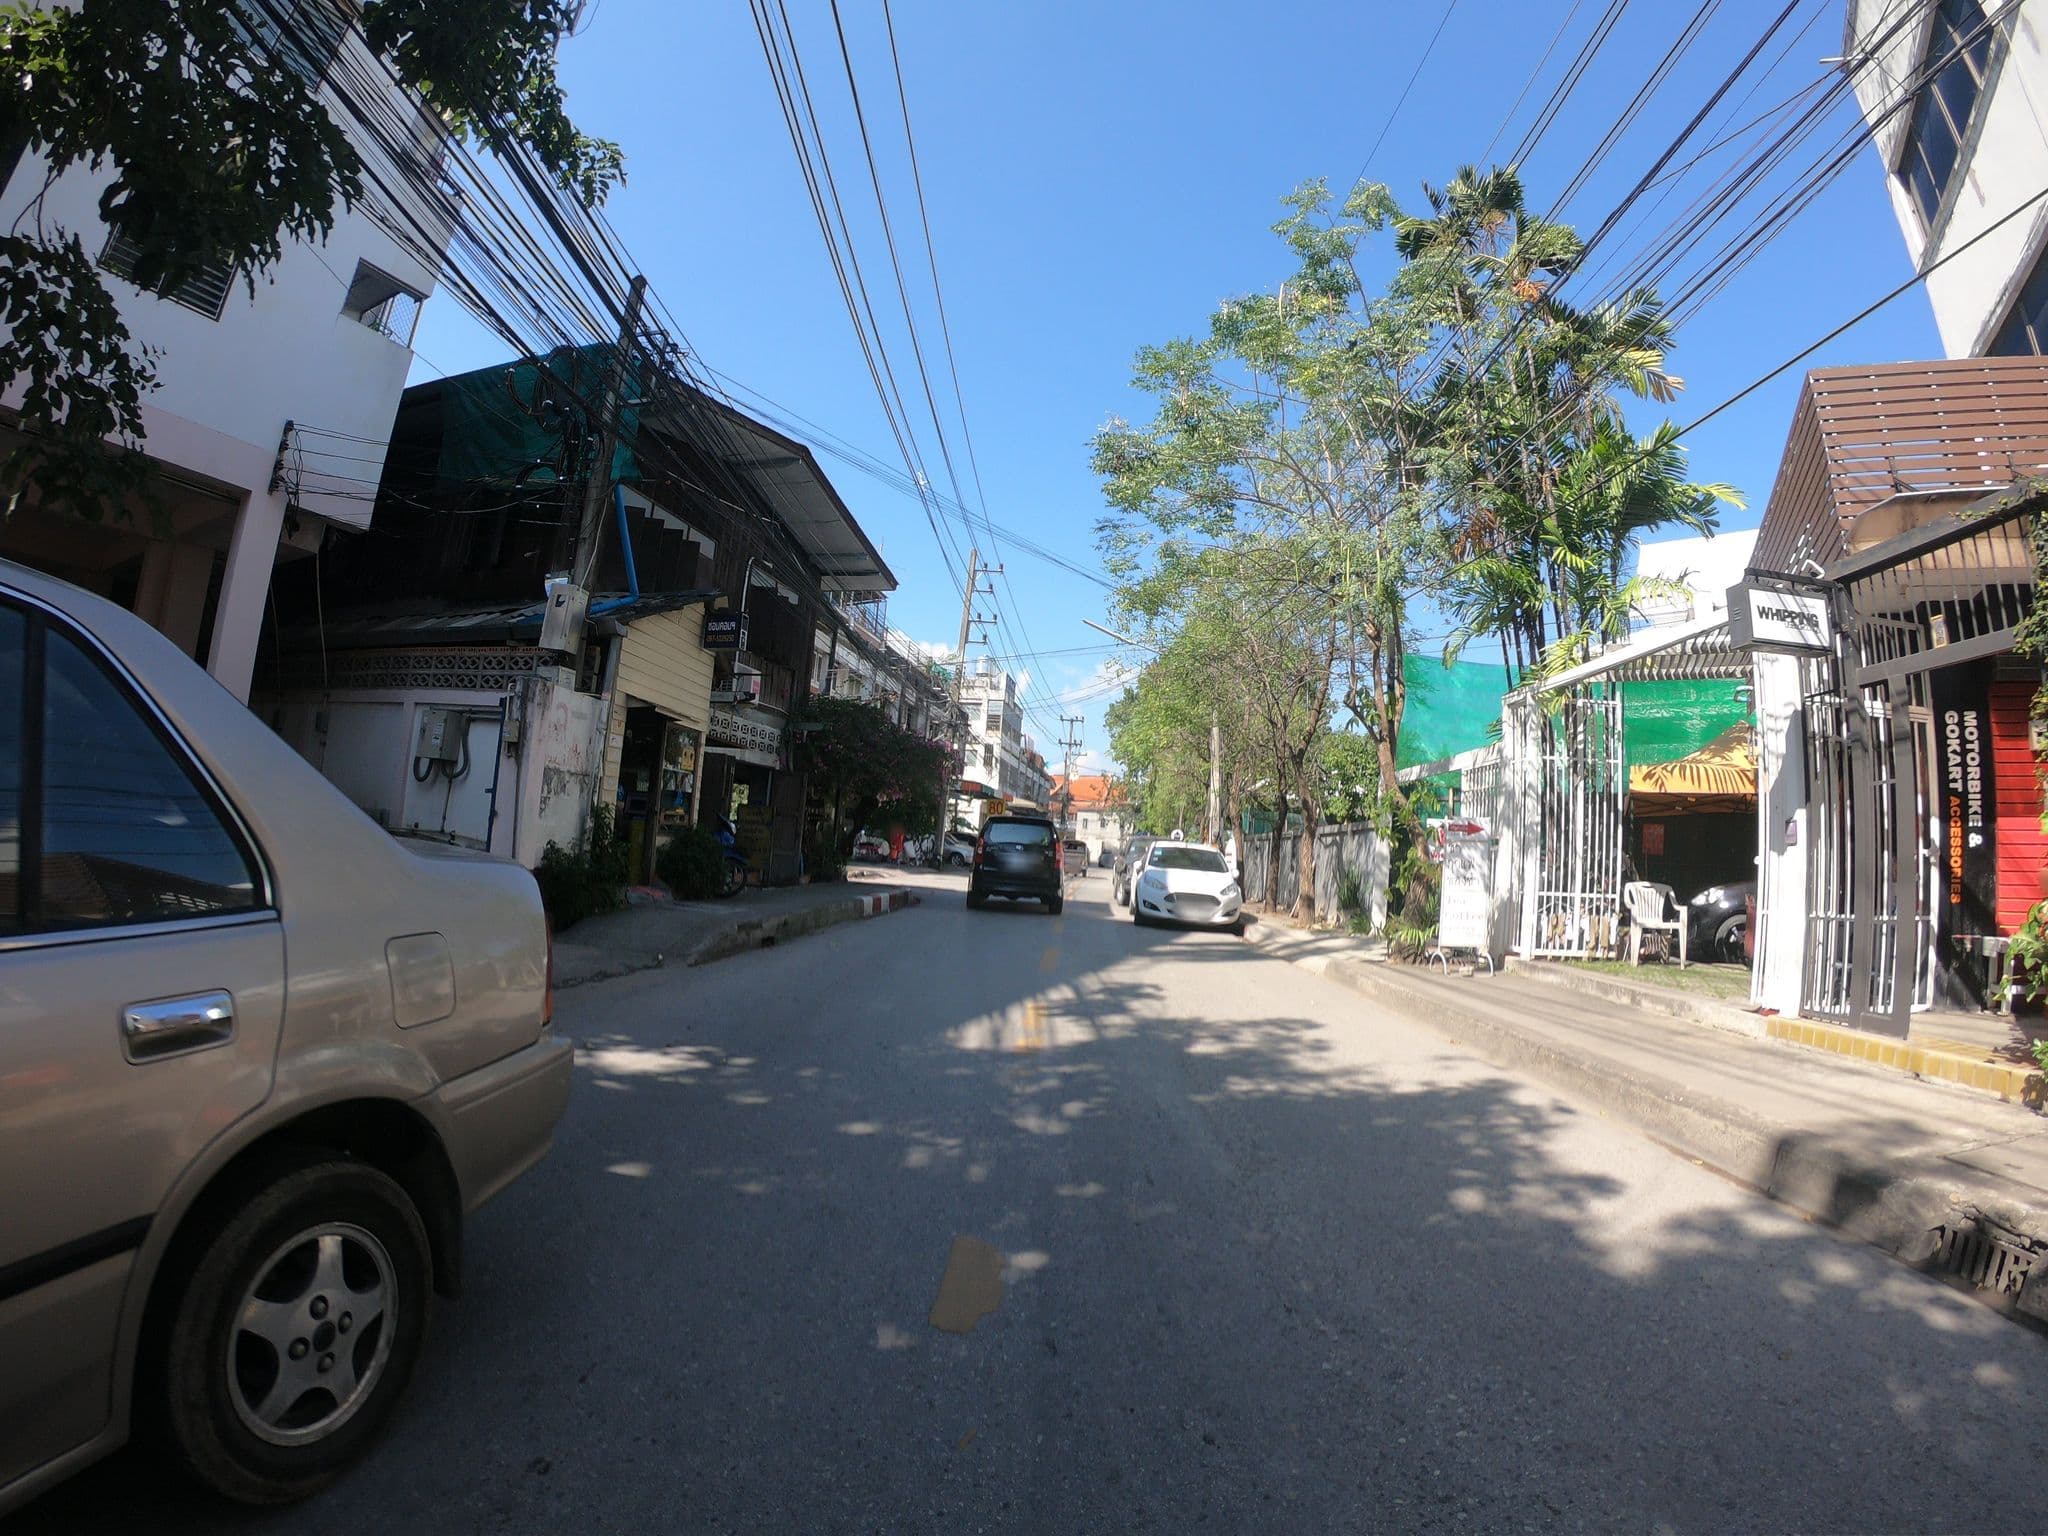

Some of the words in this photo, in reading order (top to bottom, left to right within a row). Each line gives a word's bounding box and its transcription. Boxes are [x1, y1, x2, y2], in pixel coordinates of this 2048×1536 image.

[1757, 605, 1819, 628] WHIPPING
[1945, 710, 1963, 792] GOKART
[1964, 710, 1982, 827] MOTORBIKE
[1950, 795, 1963, 904] ACCESSORIES
[1968, 832, 1983, 848] &
